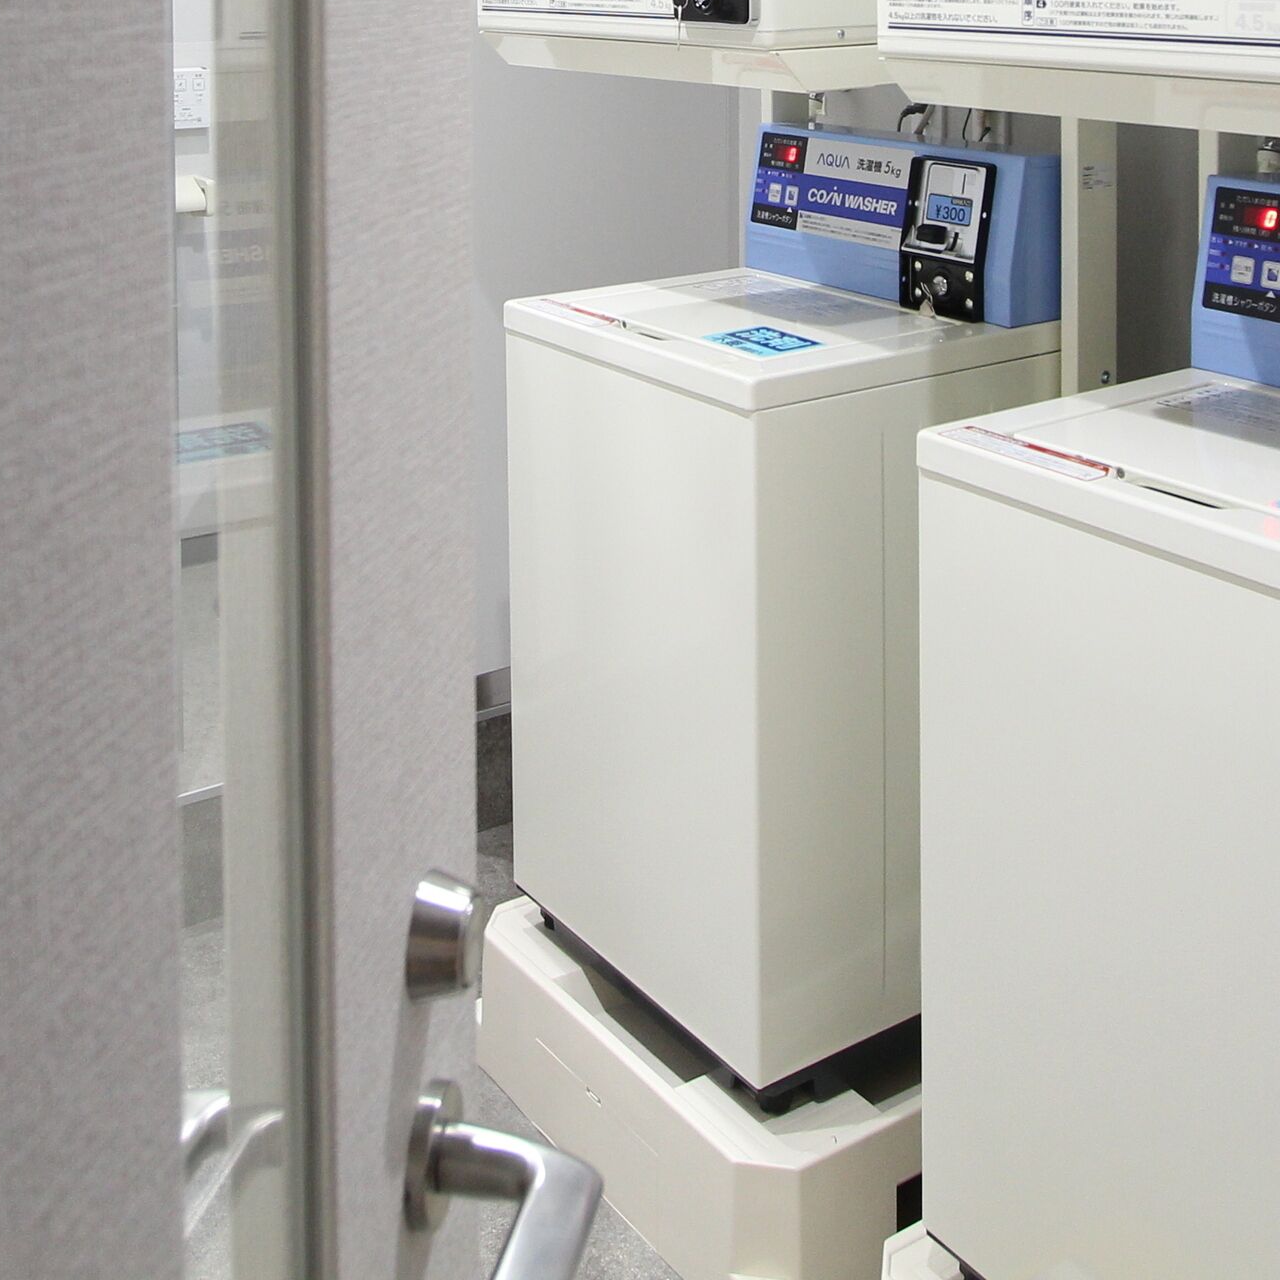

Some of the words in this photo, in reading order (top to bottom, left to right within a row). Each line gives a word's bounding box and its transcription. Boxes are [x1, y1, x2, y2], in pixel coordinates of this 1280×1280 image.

[788, 147, 798, 162] 0
[816, 152, 851, 170] AQUA
[856, 158, 883, 174] 洗濯機
[884, 161, 902, 179] 5kg
[844, 194, 898, 217] WASHER
[935, 204, 966, 222] ¥300
[1263, 209, 1278, 228] 0
